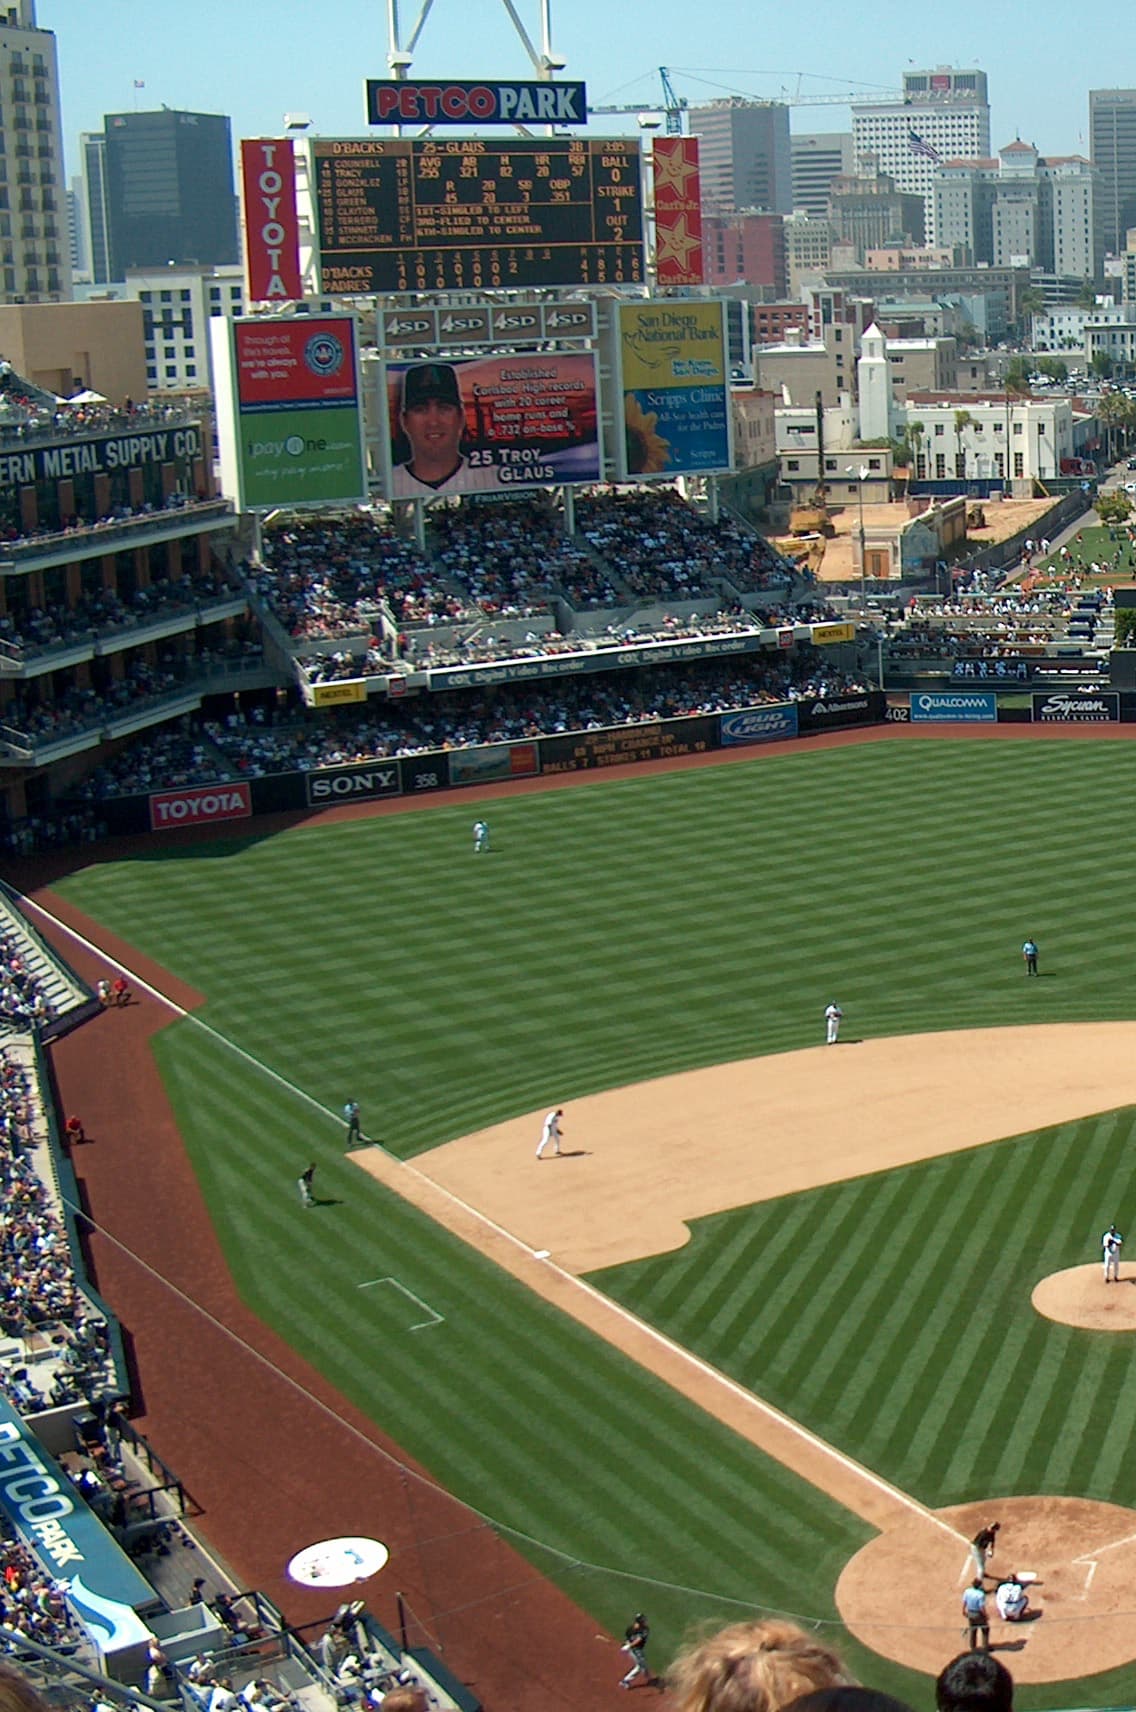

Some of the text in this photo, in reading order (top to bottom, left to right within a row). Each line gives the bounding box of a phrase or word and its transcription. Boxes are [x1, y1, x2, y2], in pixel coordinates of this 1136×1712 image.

[376, 85, 580, 120] PETCO PARK
[333, 143, 384, 154] D'BACKS
[419, 156, 442, 168] AVG
[462, 156, 478, 167] AB
[500, 155, 510, 165] H
[534, 155, 550, 166] HR
[602, 156, 629, 168] BALL
[459, 166, 478, 178] 321
[571, 165, 585, 177] 57
[445, 180, 455, 192] R
[549, 179, 572, 190] OBP
[598, 185, 636, 197] STRIKE
[259, 144, 287, 297] TOYOTA
[606, 215, 628, 226] OUT
[613, 228, 623, 241] 2
[322, 266, 374, 279] D'BACKS
[416, 264, 425, 276] 0
[455, 262, 463, 274] 0
[473, 262, 482, 274] 0
[492, 261, 500, 274] 0
[509, 262, 518, 273] 2
[580, 259, 589, 270] 4
[616, 258, 622, 269] 1
[322, 279, 371, 292] PADRES
[398, 277, 407, 290] 0
[418, 277, 426, 289] 0
[436, 276, 445, 288] 0
[474, 275, 482, 287] 0
[492, 275, 500, 287] 0
[615, 270, 623, 281] 0
[386, 317, 430, 335] 4SD
[441, 315, 484, 332] 4SD
[493, 312, 536, 330] 4SD
[546, 310, 587, 327] 4SD
[638, 312, 697, 327] San Diego
[638, 326, 720, 342] National Bank
[500, 368, 558, 381] Established
[474, 381, 585, 396] Carlsbad High records
[494, 396, 566, 408] with 20 career
[647, 392, 687, 409] Scripps
[493, 408, 569, 422] home runs and
[522, 422, 564, 434] on-base
[44, 444, 103, 478] METAL
[105, 434, 168, 469] SUPPLY
[174, 430, 200, 456] CO.
[470, 448, 541, 466] 25 TROY
[499, 465, 555, 481] GLAUS
[617, 640, 746, 664] COX Digital Video Recorder
[448, 660, 585, 685] COX Digital Video Recorder
[919, 695, 988, 711] QUALCOMM
[1041, 695, 1108, 717] Sycuan
[885, 708, 907, 721] 402
[734, 712, 792, 734] BUD LIGHT
[660, 743, 691, 756] TOTAL
[311, 770, 394, 798] SONY
[415, 773, 438, 789] 358
[157, 792, 247, 821] TOYOTA
[31, 1518, 85, 1568] PARK
